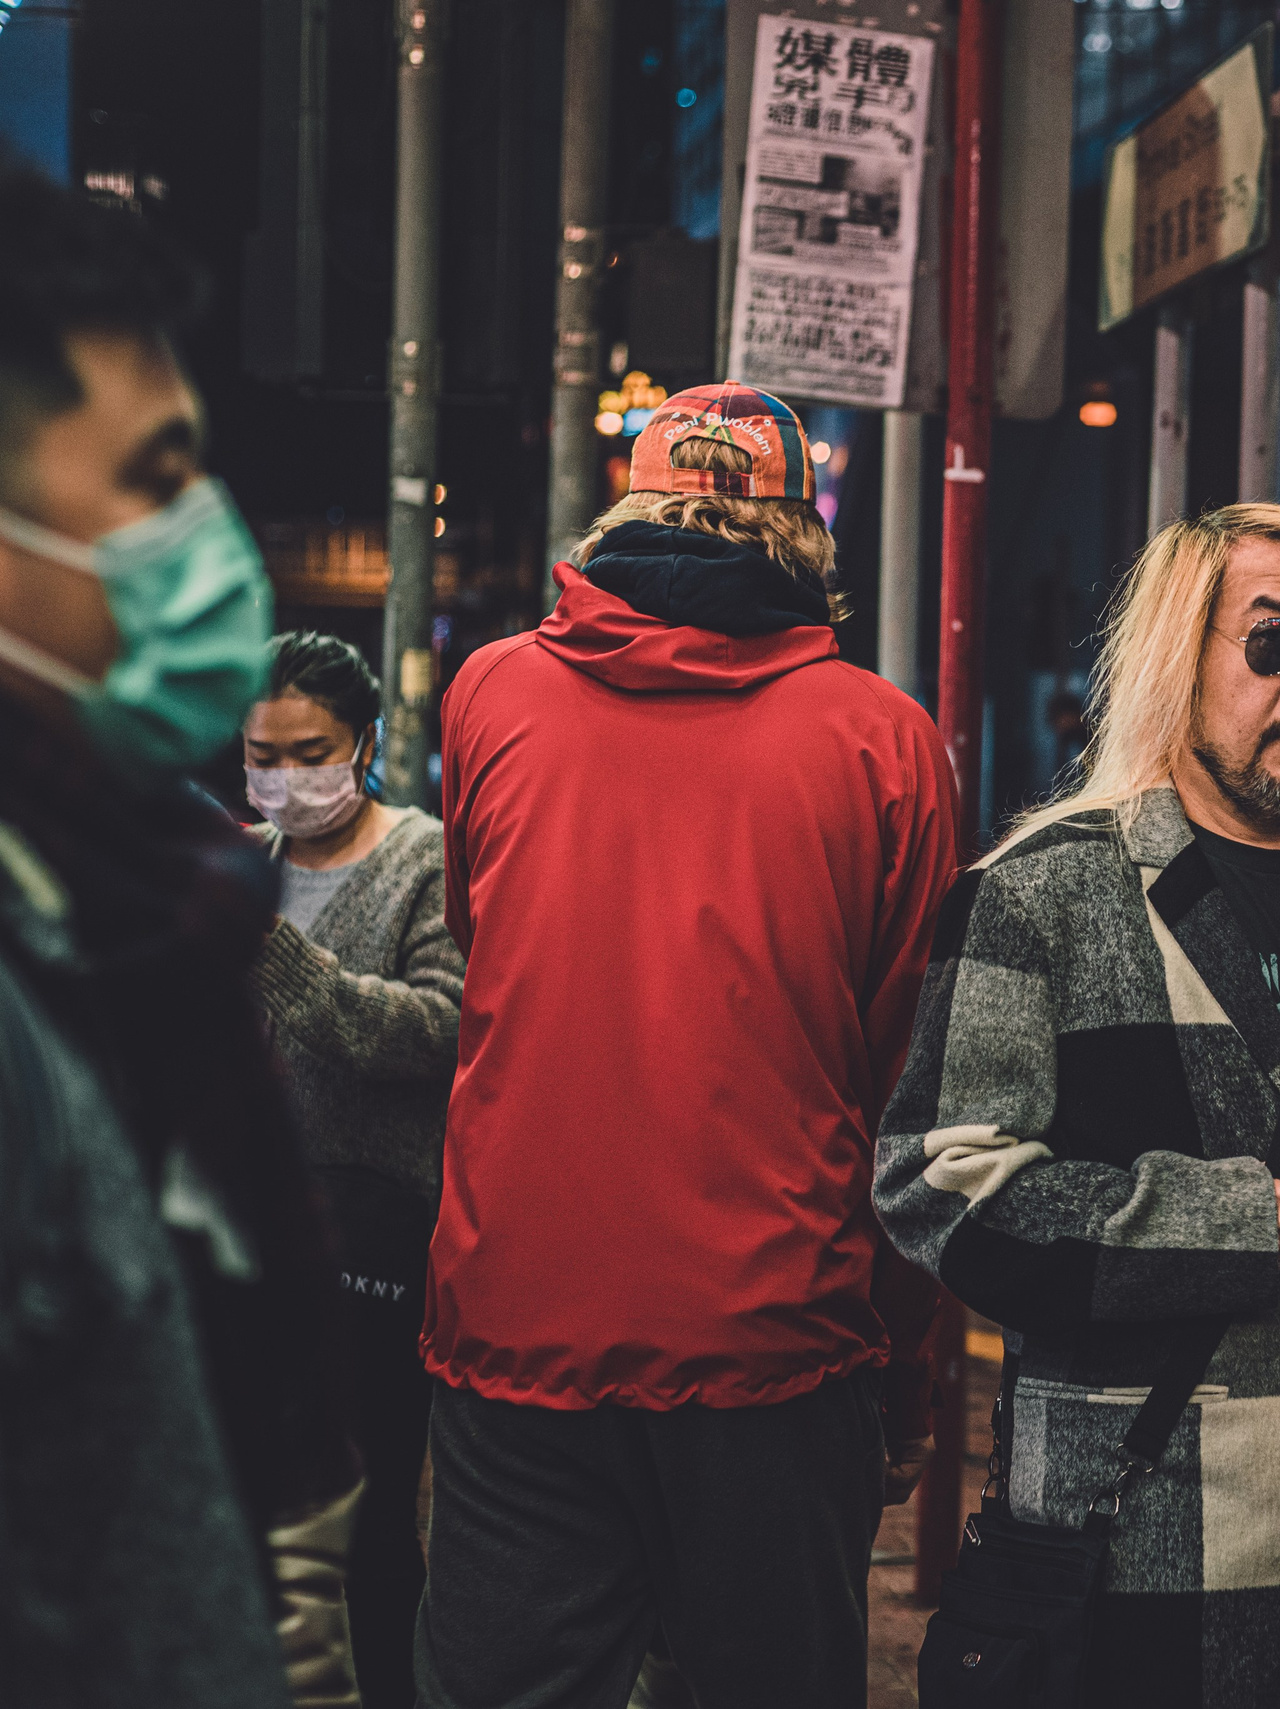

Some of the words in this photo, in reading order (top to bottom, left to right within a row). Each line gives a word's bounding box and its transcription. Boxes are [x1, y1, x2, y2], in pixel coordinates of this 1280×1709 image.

[775, 26, 911, 92] 媒體
[705, 412, 772, 456] Pwoblem
[341, 1271, 406, 1302] DKNY
